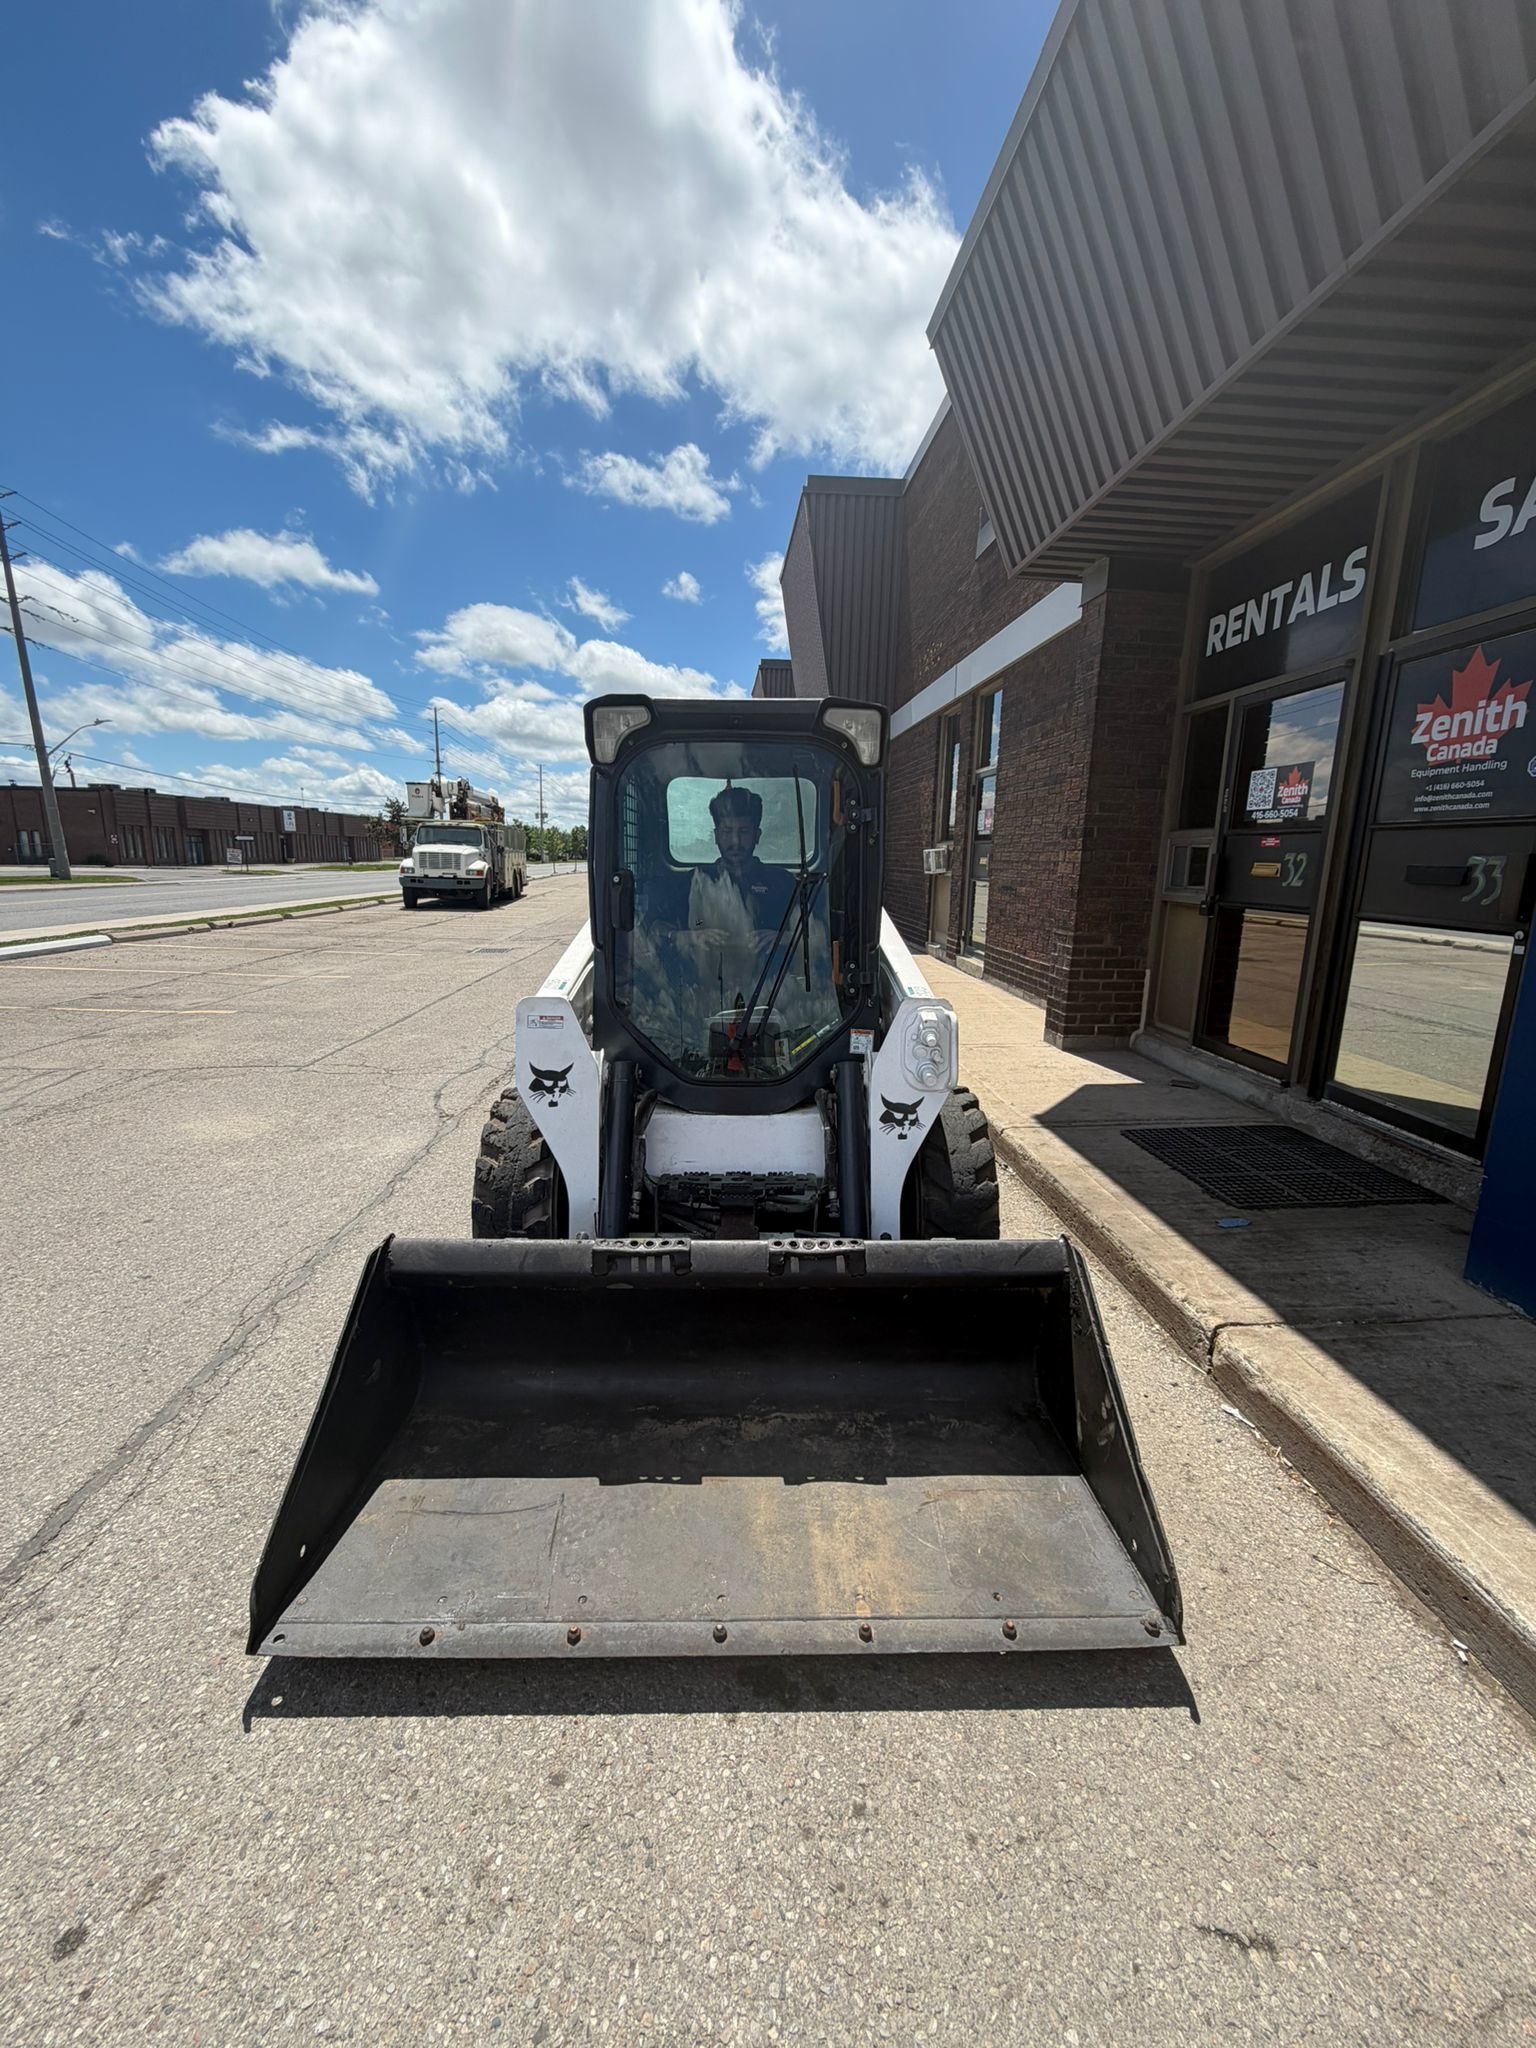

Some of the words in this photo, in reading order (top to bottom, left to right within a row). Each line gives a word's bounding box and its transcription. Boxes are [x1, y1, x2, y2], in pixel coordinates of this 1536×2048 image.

[1206, 546, 1368, 657] RENTALS
[1411, 694, 1528, 744] Zenith
[1426, 736, 1498, 762] Canada
[1411, 765, 1460, 779] Equipment
[1462, 760, 1508, 773] Handling
[1277, 783, 1309, 797] Zenith
[1450, 779, 1485, 790] 660-5054
[1251, 808, 1299, 820] 416-660-5054
[1413, 802, 1490, 813] www.zenithcanada.com
[1282, 852, 1308, 887] 32
[1461, 855, 1508, 906] 33
